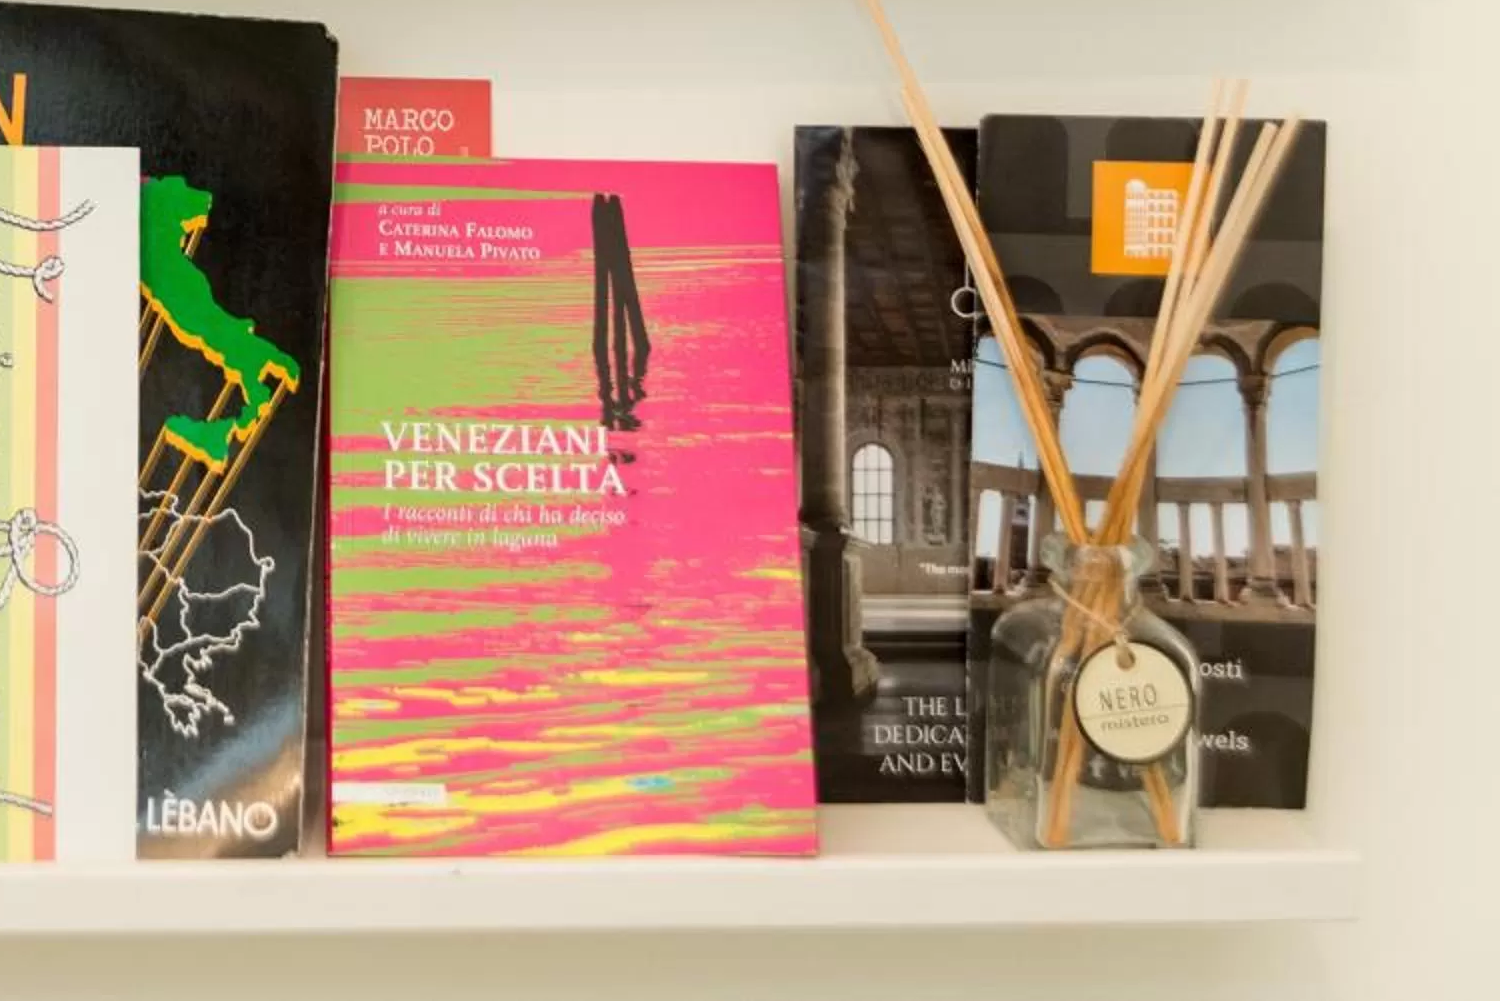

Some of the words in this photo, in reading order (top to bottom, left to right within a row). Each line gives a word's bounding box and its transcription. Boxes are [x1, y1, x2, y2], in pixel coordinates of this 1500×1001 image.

[363, 107, 455, 132] MARCO
[364, 134, 435, 157] POLO
[391, 203, 423, 217] cura
[427, 202, 442, 217] di
[378, 220, 460, 239] CATERINA
[465, 221, 534, 241] FALOMO
[394, 240, 475, 259] MANUELA
[480, 242, 541, 261] PIVATO
[380, 420, 610, 457] VENEZIANI
[383, 459, 460, 492] PER
[472, 462, 627, 496] SCELTA
[397, 504, 473, 524] racconti
[479, 504, 499, 524] di
[503, 505, 533, 525] chi
[539, 505, 564, 525] ha
[569, 506, 626, 525] deciso
[381, 526, 401, 544] di
[406, 530, 465, 545] vivere
[467, 528, 486, 547] in
[492, 530, 558, 552] laguna
[900, 695, 949, 718] THE
[1099, 682, 1157, 712] NERO
[878, 752, 936, 775] AND
[145, 789, 279, 839] LÈBANO
